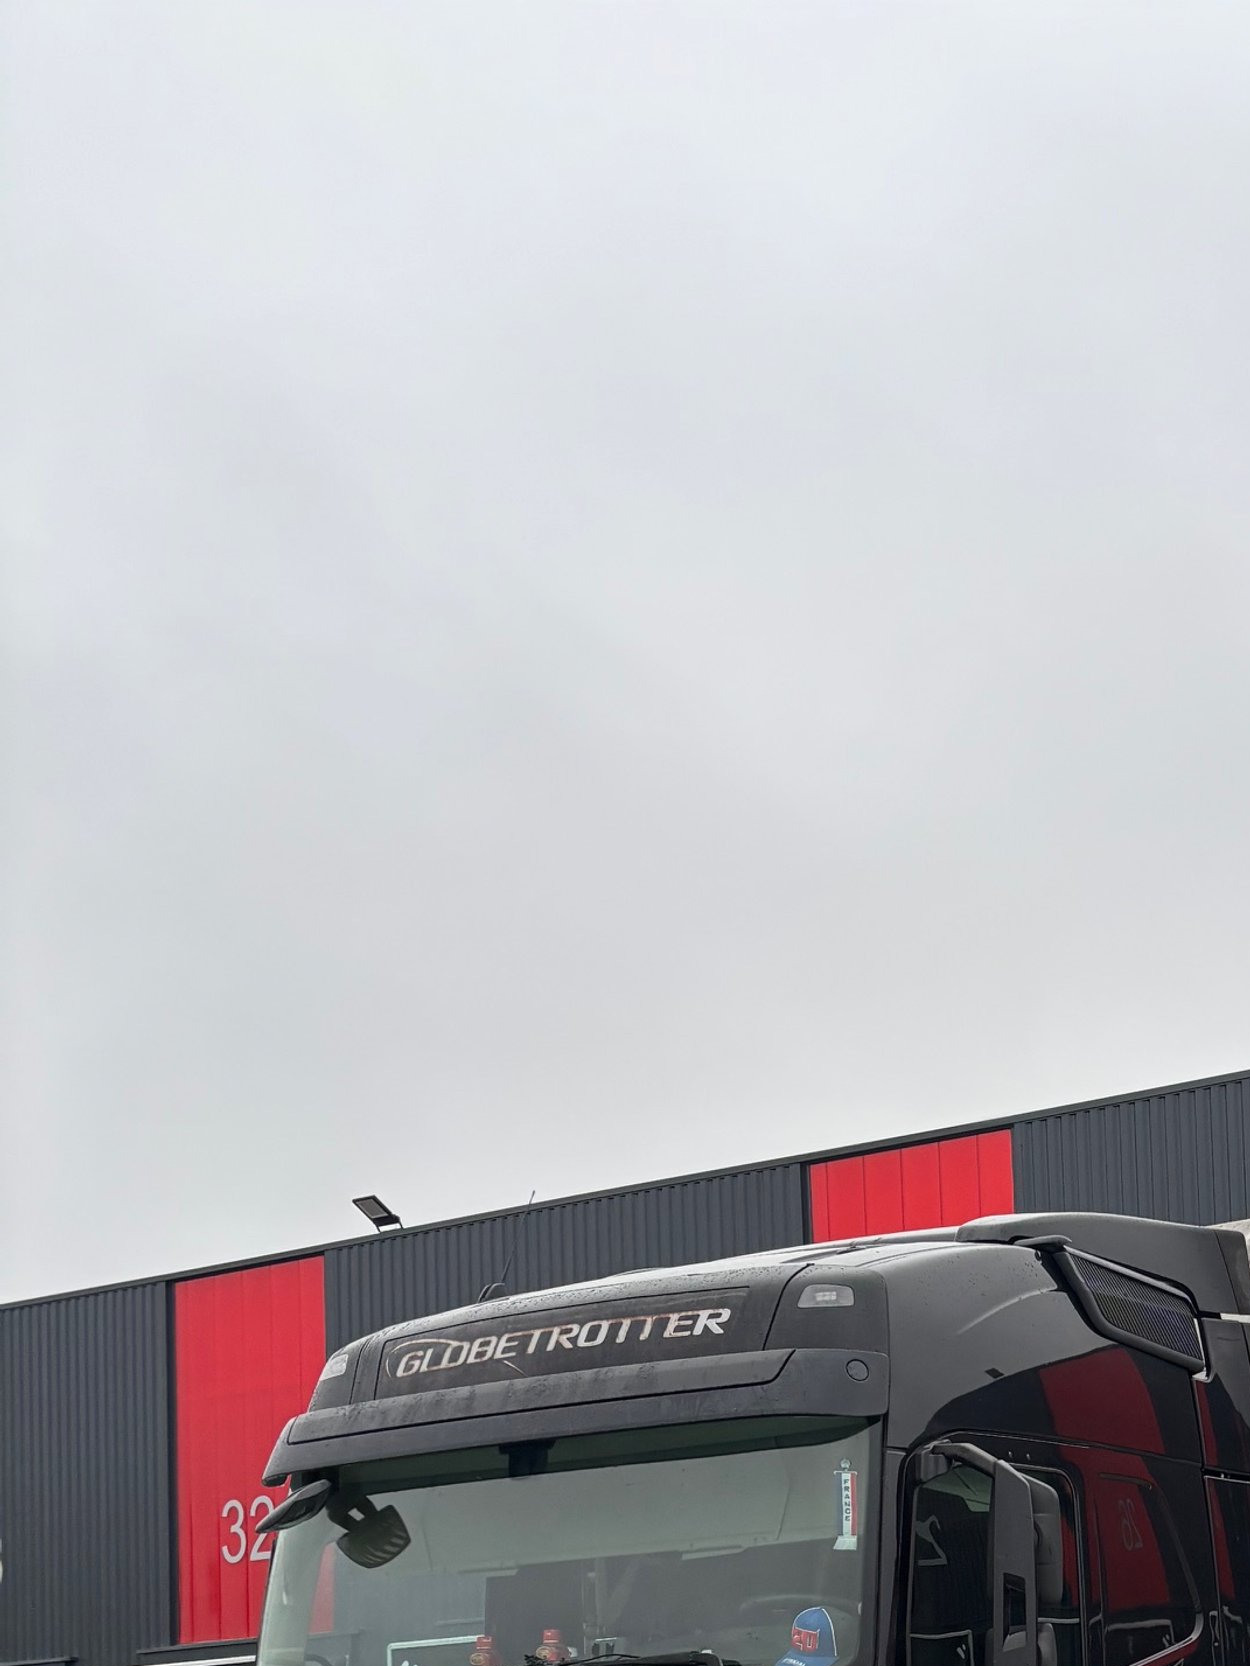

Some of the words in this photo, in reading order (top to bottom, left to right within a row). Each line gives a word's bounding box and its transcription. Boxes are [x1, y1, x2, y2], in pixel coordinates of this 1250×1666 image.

[396, 1308, 731, 1378] GLOBETROTTER
[221, 1495, 275, 1564] 32
[843, 1478, 851, 1522] FRANCE
